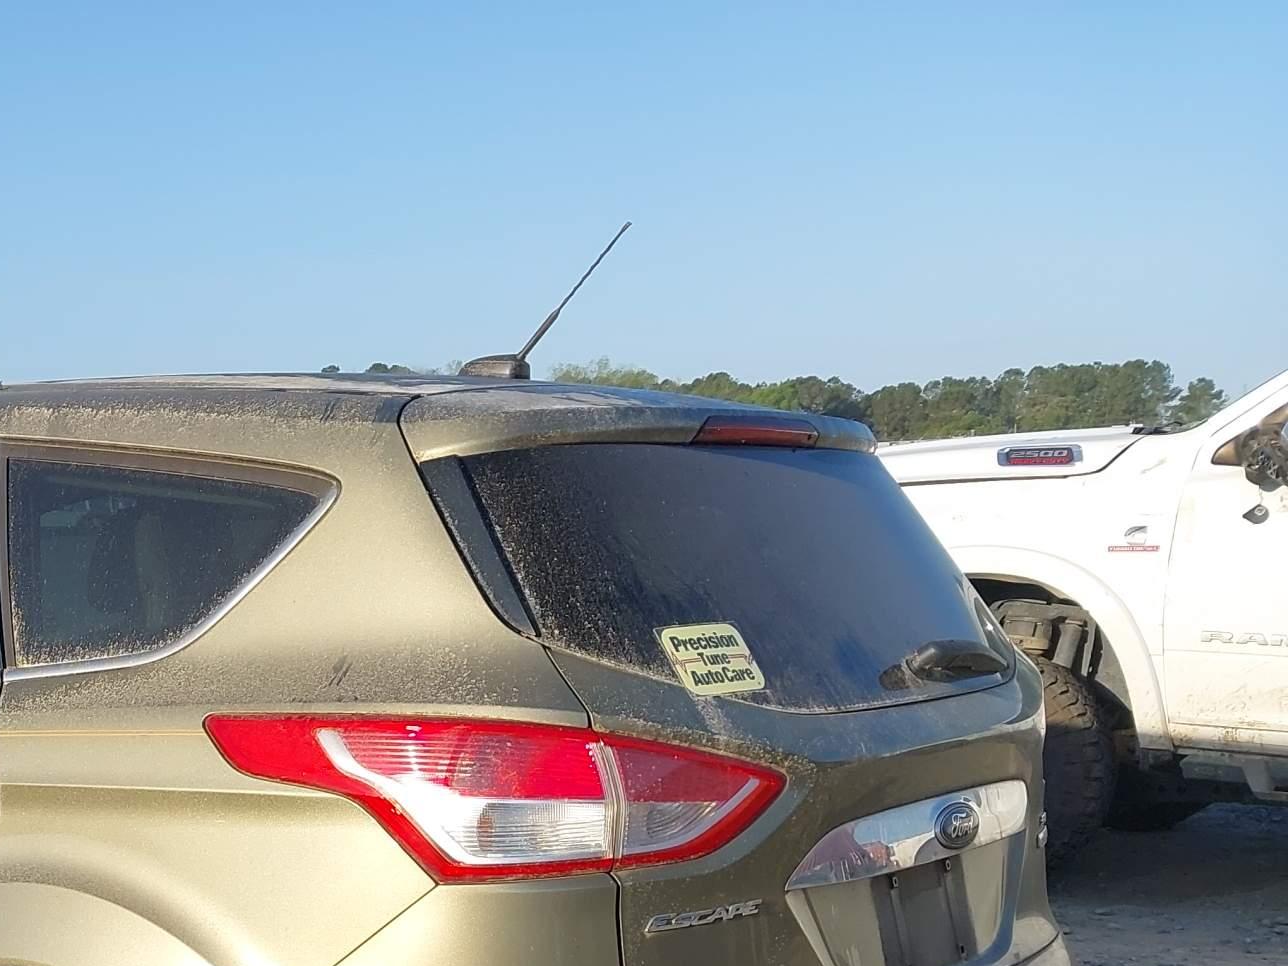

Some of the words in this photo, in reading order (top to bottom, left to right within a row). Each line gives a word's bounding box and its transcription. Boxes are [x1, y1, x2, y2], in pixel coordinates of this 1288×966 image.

[1011, 450, 1068, 458] 2500
[669, 631, 740, 653] Precision
[696, 652, 732, 667] Tune
[951, 812, 974, 838] Ford
[644, 898, 763, 933] ESCAPE
